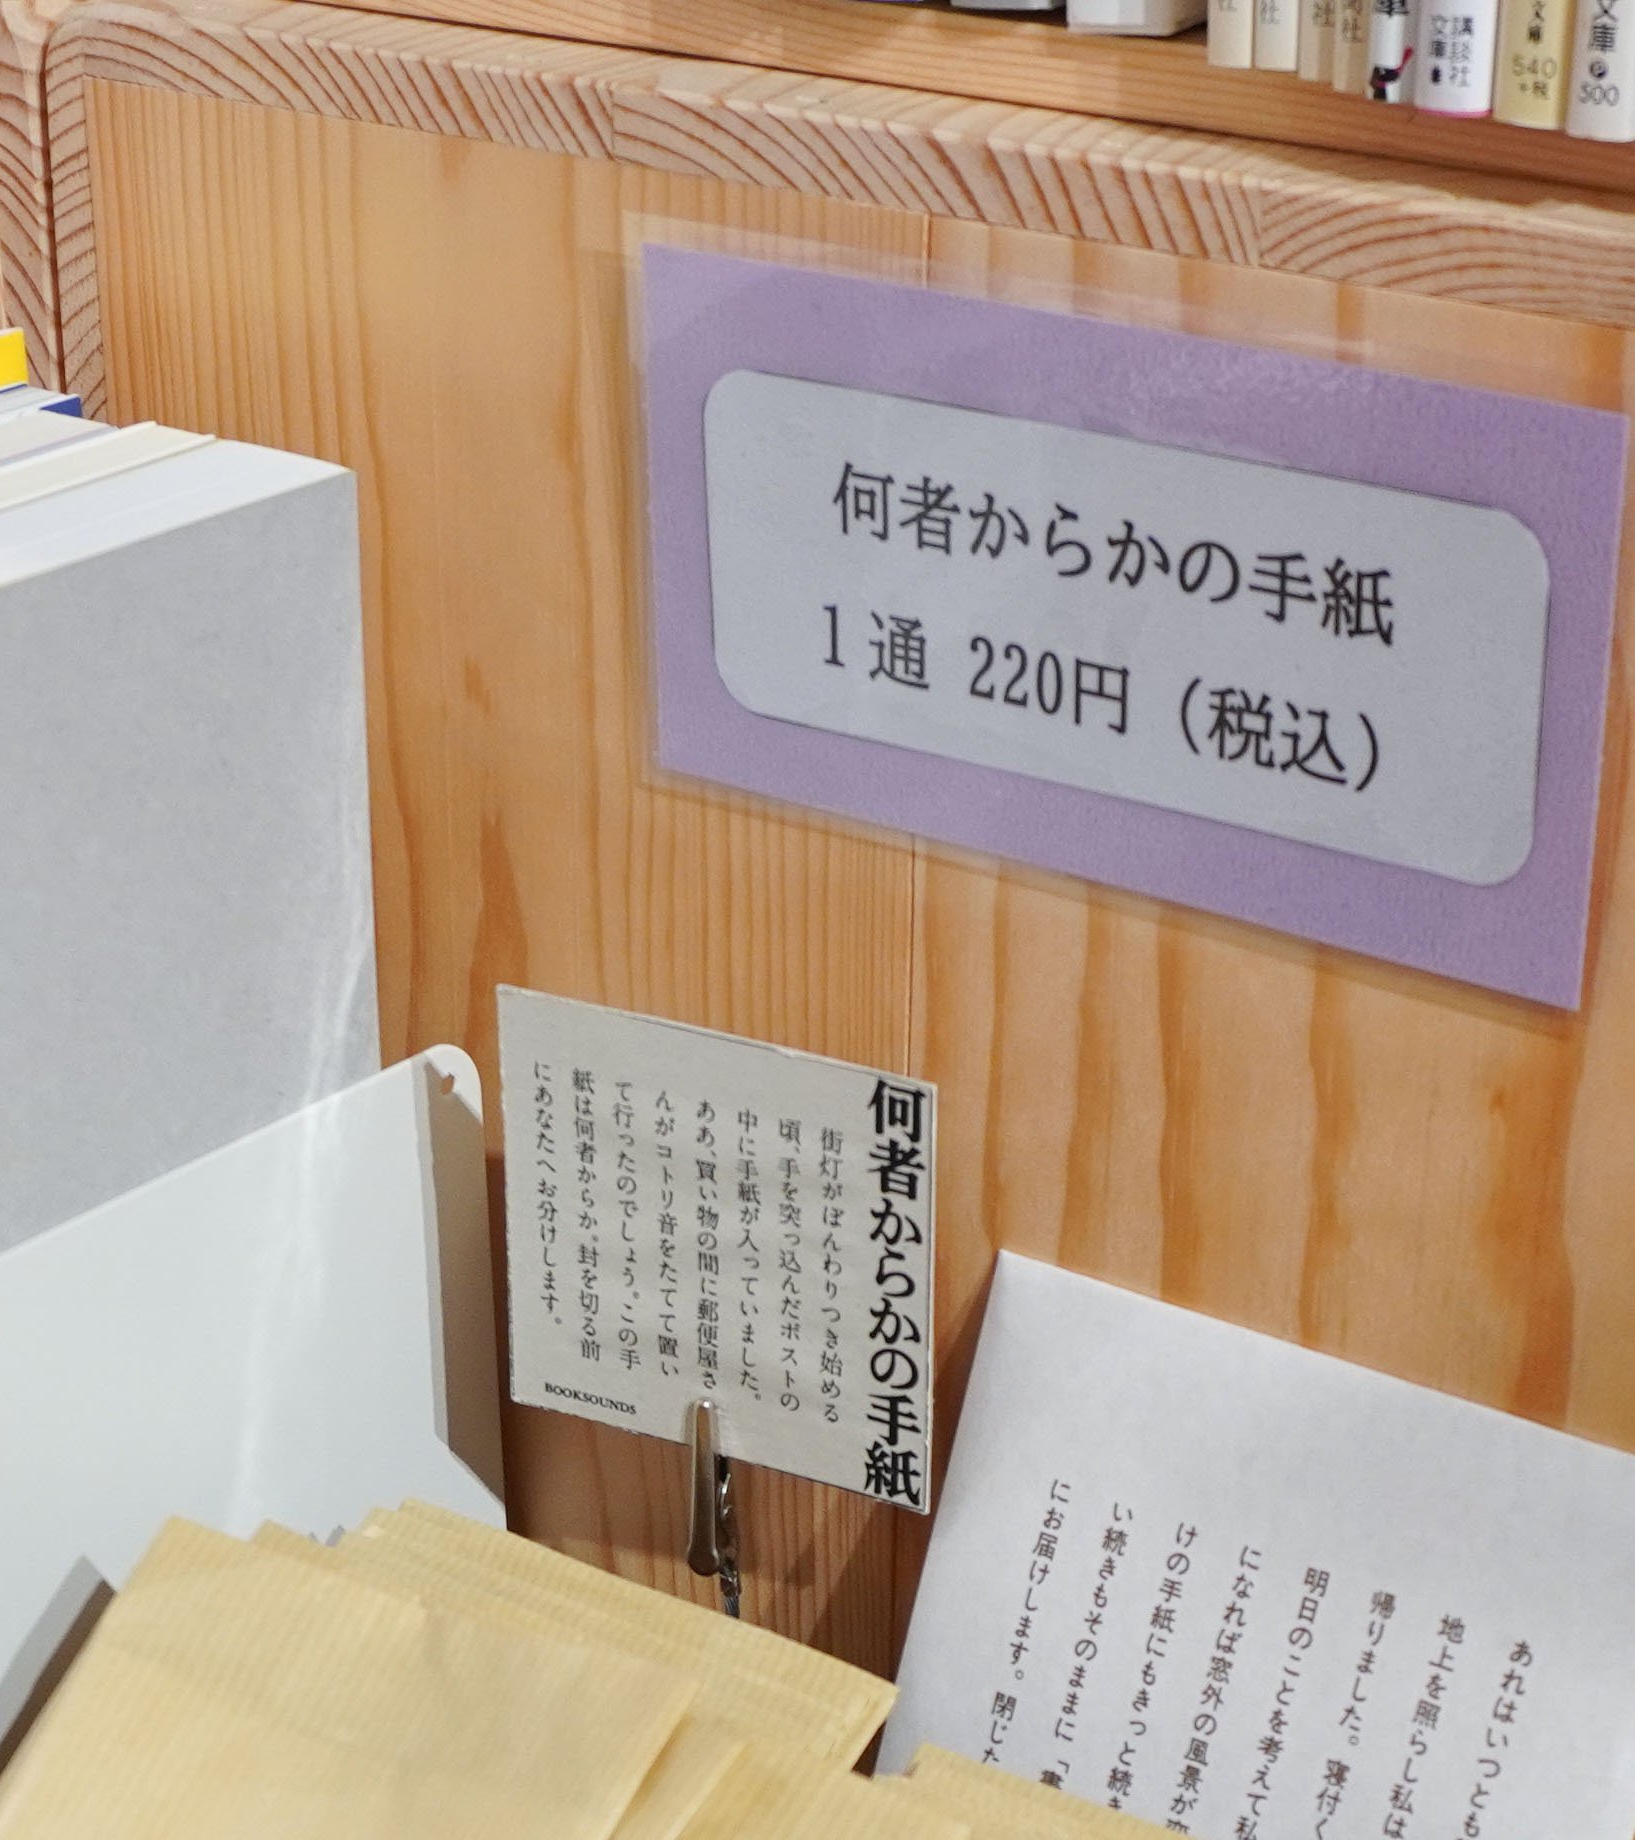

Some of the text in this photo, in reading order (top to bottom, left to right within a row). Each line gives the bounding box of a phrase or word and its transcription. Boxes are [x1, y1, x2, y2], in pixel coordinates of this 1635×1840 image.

[832, 462, 1395, 647] 何者からかの手紙
[968, 634, 1132, 735] 220円
[533, 1060, 564, 1326] にあなたへお分けします。
[863, 1077, 927, 1506] 何者からかの手紙
[543, 1380, 638, 1416] BOOKSOUNDS
